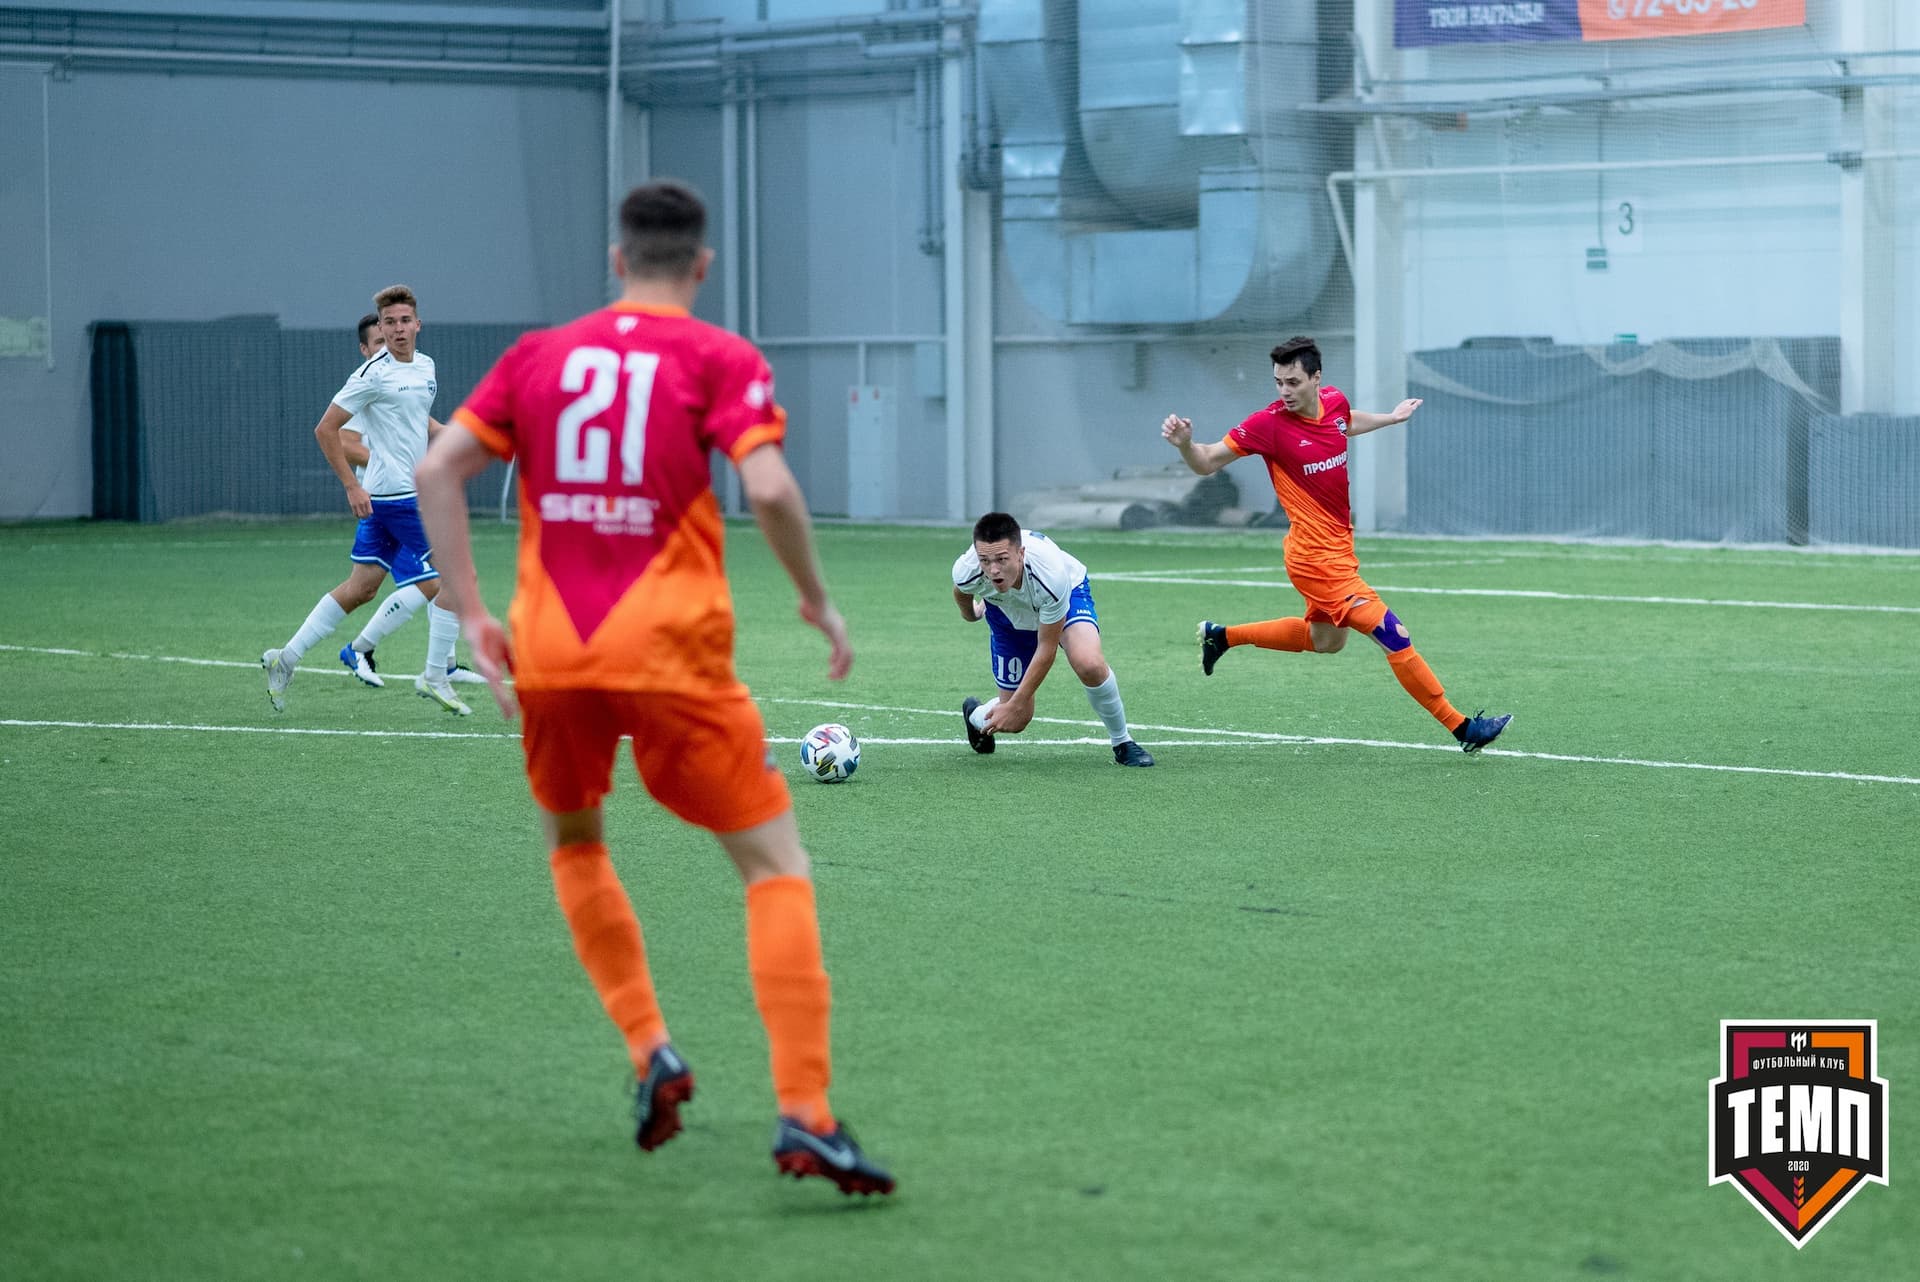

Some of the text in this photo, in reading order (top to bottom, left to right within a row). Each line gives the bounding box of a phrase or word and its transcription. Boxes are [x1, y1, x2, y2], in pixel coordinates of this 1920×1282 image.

[1618, 202, 1634, 235] 3
[556, 346, 660, 486] 21
[996, 655, 1023, 683] 19
